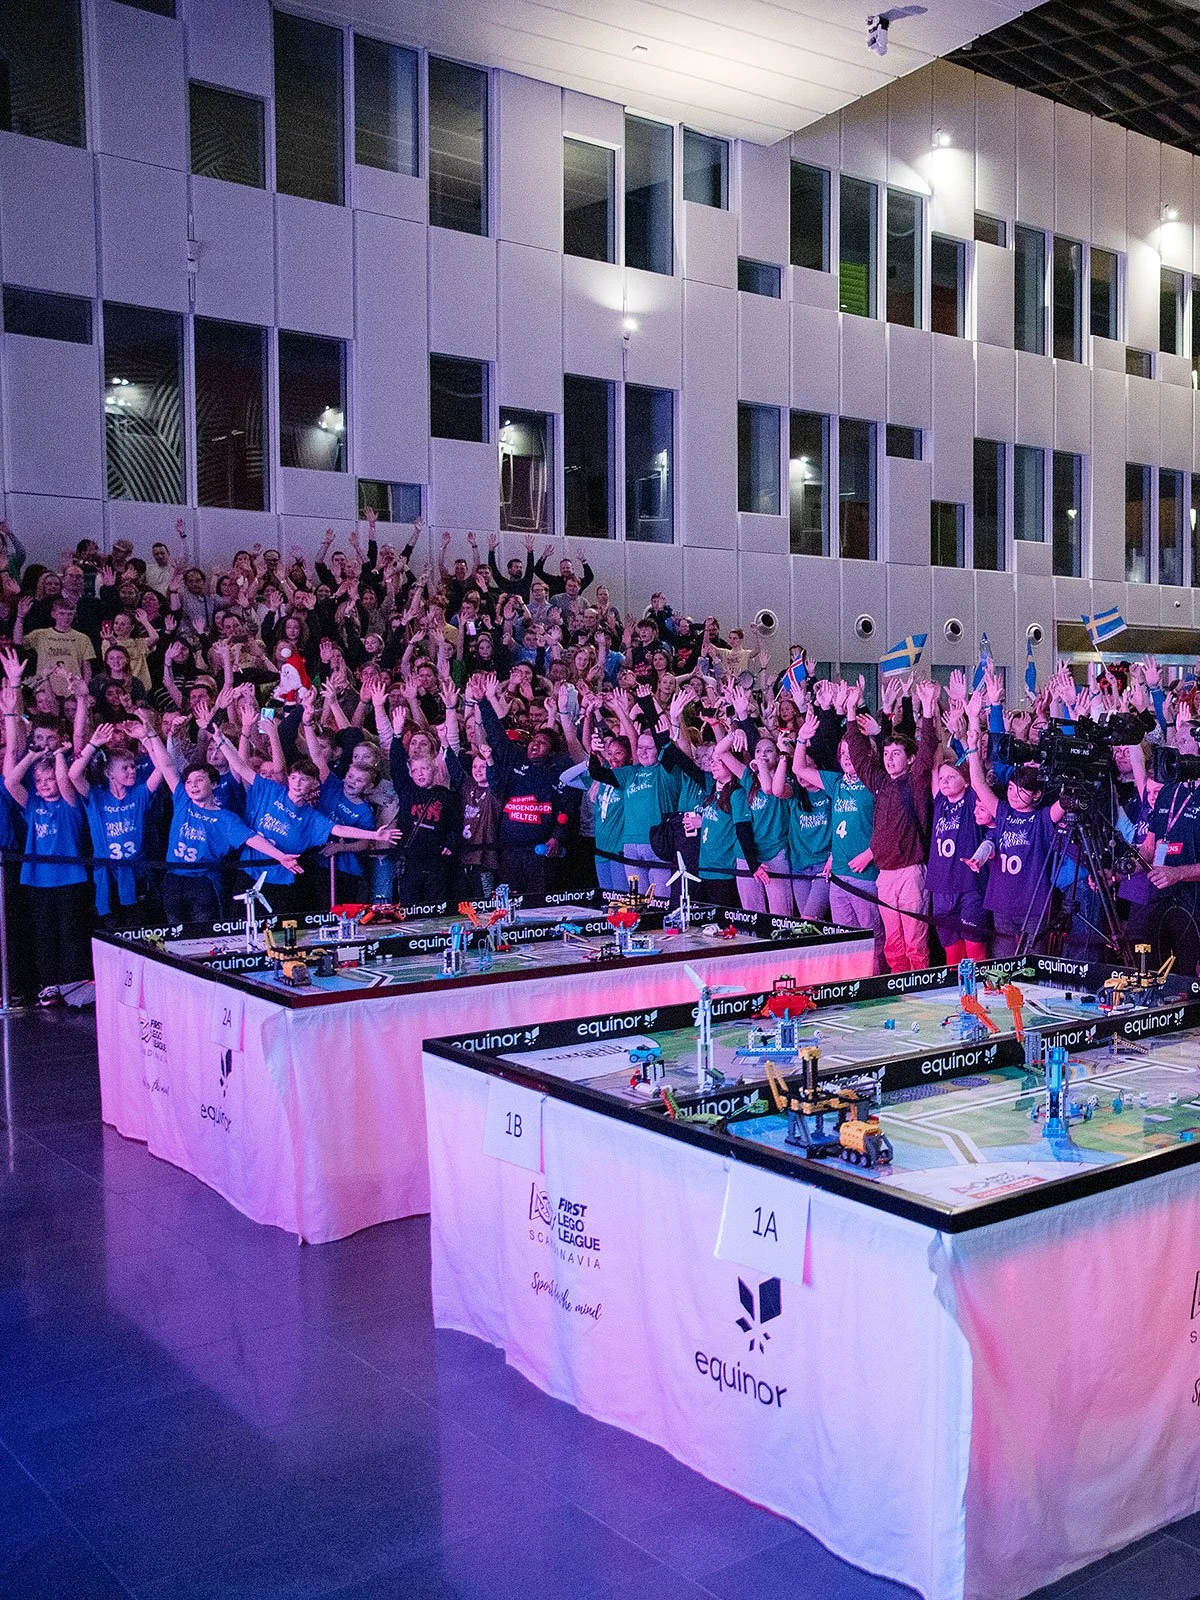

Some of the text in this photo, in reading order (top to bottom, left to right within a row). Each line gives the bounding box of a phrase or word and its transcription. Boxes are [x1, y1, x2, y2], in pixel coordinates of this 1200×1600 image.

[511, 811, 538, 822] HELTER
[463, 824, 472, 839] 6
[836, 820, 847, 838] 4
[109, 841, 136, 860] 33
[174, 842, 198, 862] 33
[937, 838, 956, 858] 10
[1000, 853, 1022, 875] 10
[472, 897, 508, 912] equi
[545, 890, 585, 904] equinor
[305, 911, 340, 926] equin
[399, 904, 436, 919] quinor
[724, 909, 751, 923] equinor
[501, 927, 549, 943] equinor
[585, 921, 614, 934] equi
[408, 935, 453, 951] equino
[1038, 958, 1079, 976] equinor
[124, 970, 133, 987] 2B
[887, 971, 936, 992] equinor
[812, 986, 847, 1001] uinor
[222, 1007, 232, 1028] 2A
[691, 999, 750, 1020] euinor
[577, 1014, 642, 1038] equinor
[1124, 1012, 1173, 1036] equinor
[1040, 1031, 1084, 1054] quinor
[920, 1049, 983, 1077] equinor
[679, 1097, 740, 1117] quinor
[505, 1110, 524, 1140] 1B
[558, 1197, 588, 1218] FIRST
[558, 1212, 585, 1233] LEGO
[752, 1206, 778, 1242] 1A
[529, 1229, 601, 1270] SCANAVIA
[558, 1227, 601, 1252] LEAGUE
[574, 1302, 603, 1321] mind
[694, 1350, 788, 1408] equinor
